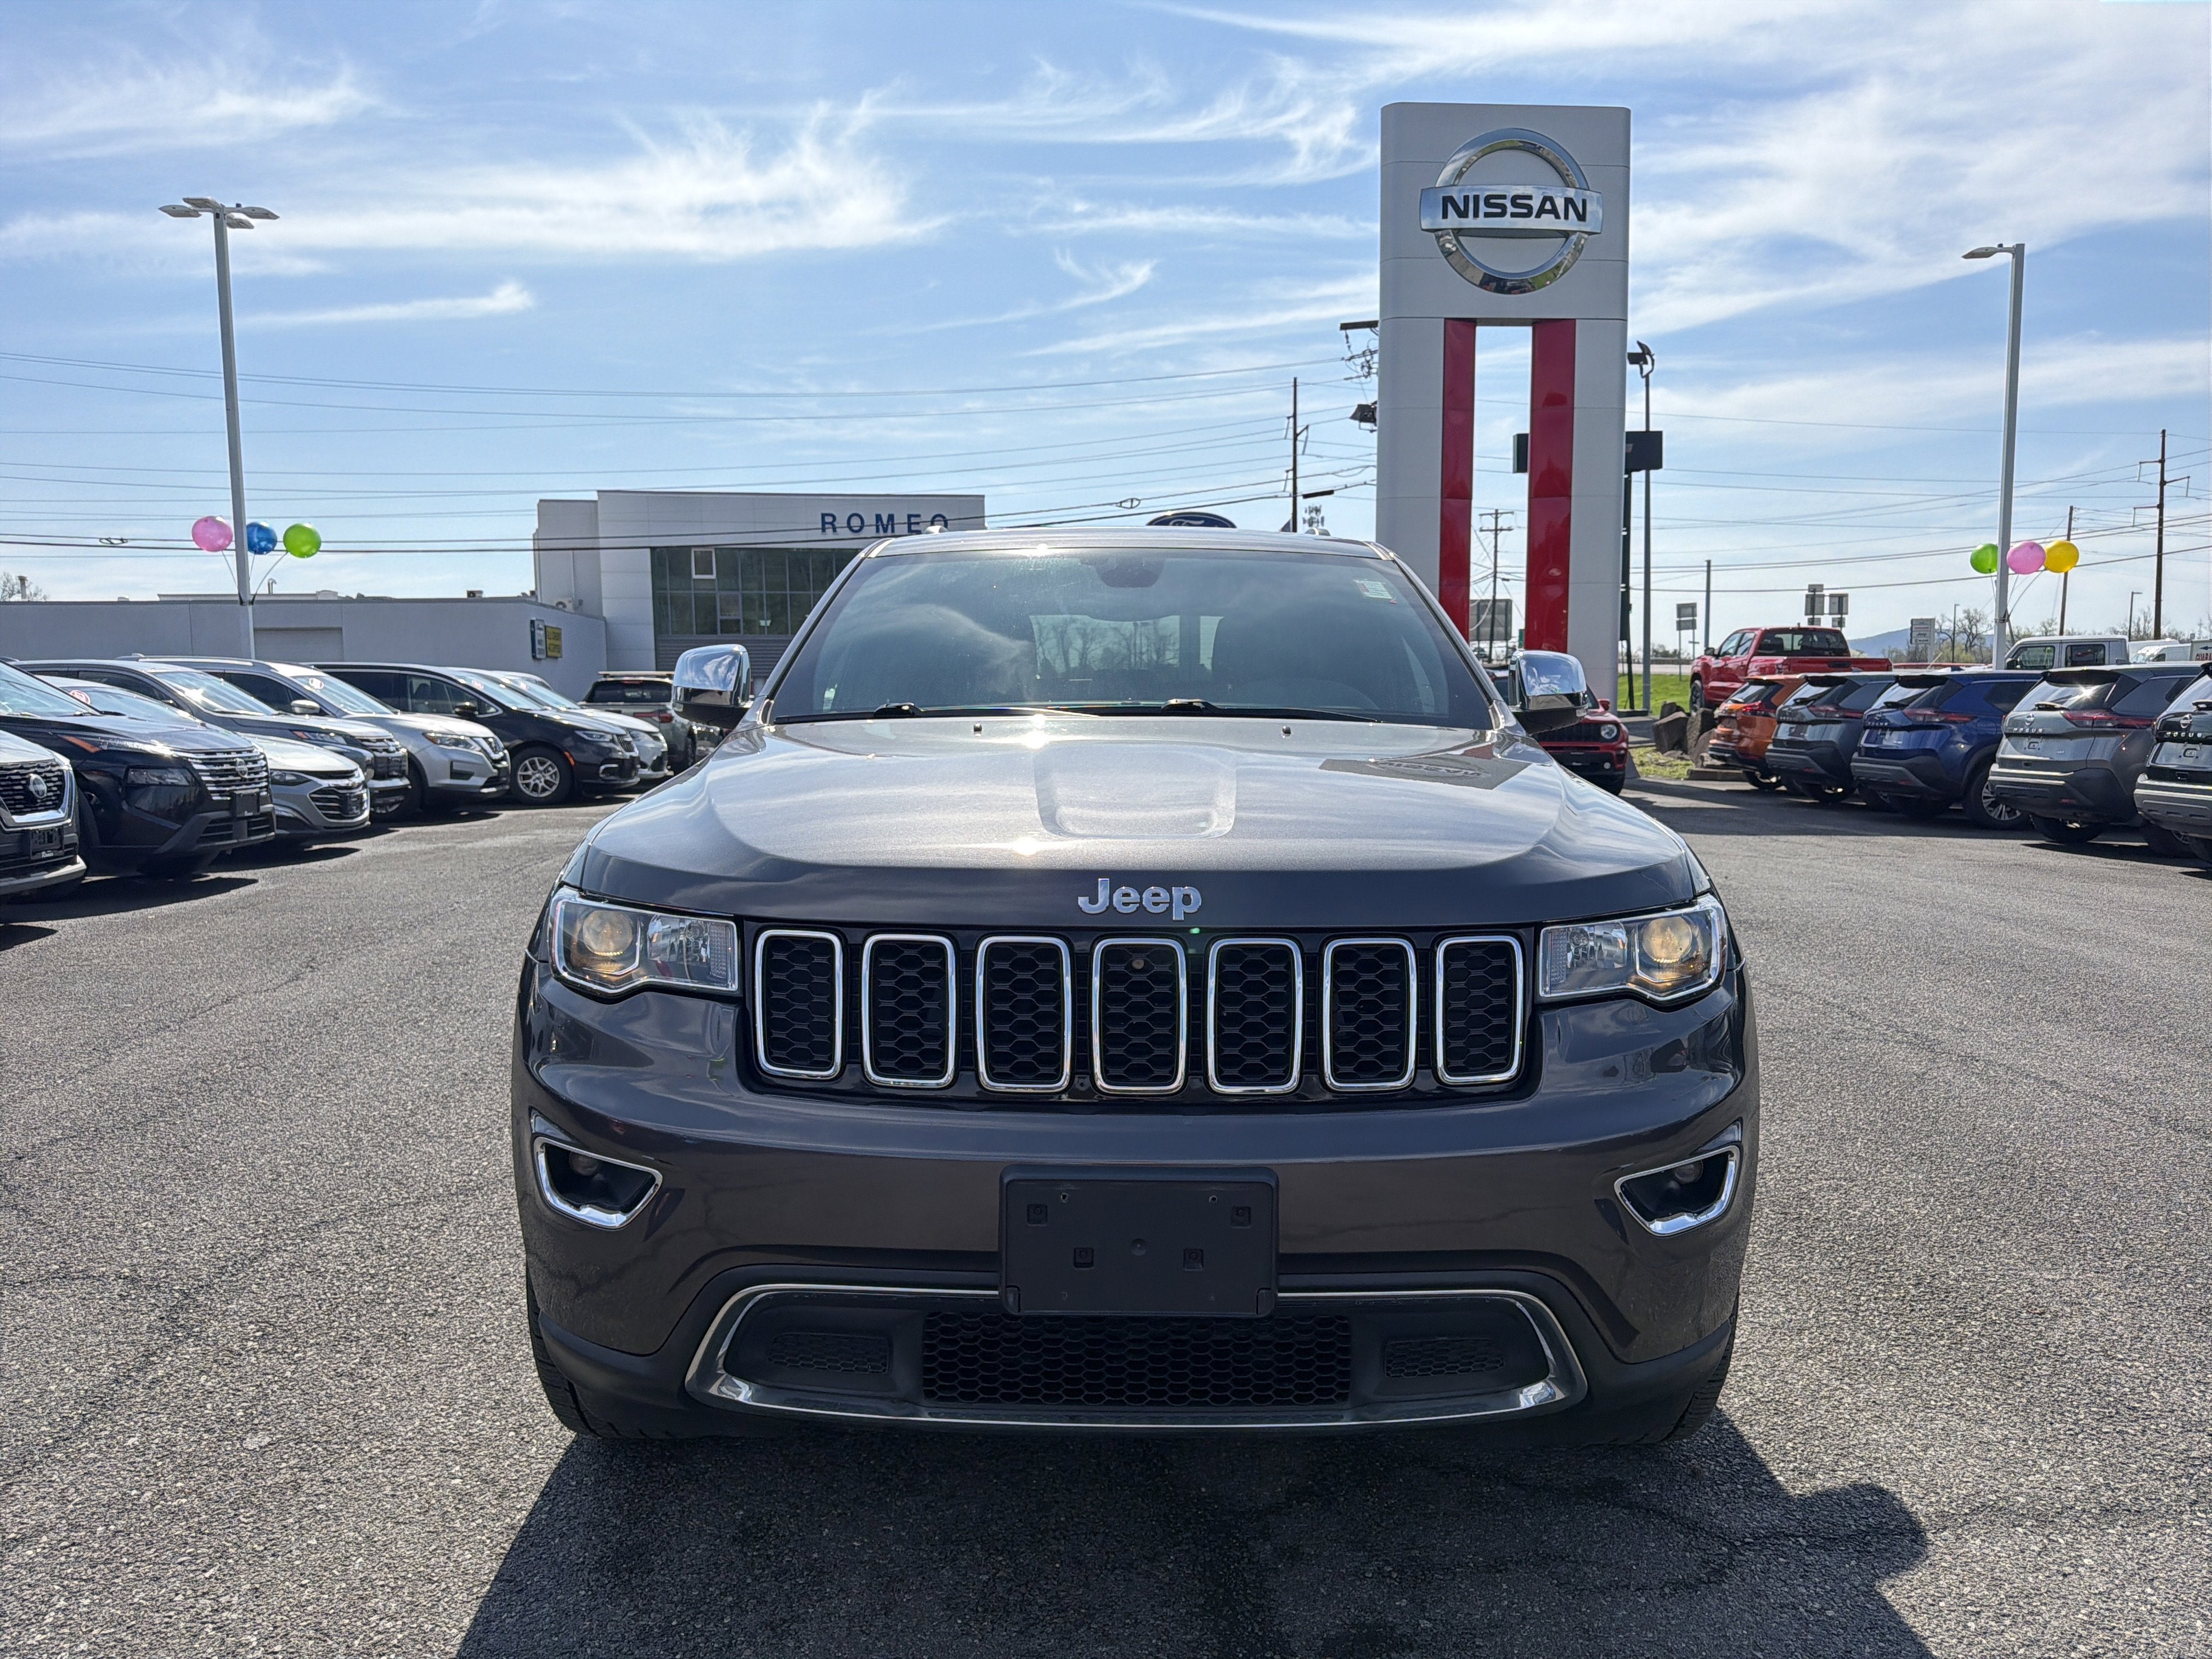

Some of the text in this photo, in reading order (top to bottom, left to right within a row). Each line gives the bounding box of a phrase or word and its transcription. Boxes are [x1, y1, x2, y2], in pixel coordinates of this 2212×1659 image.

[1442, 194, 1587, 222] NISSAN
[821, 512, 949, 534] ROMEO
[1077, 878, 1202, 921] Jeep
